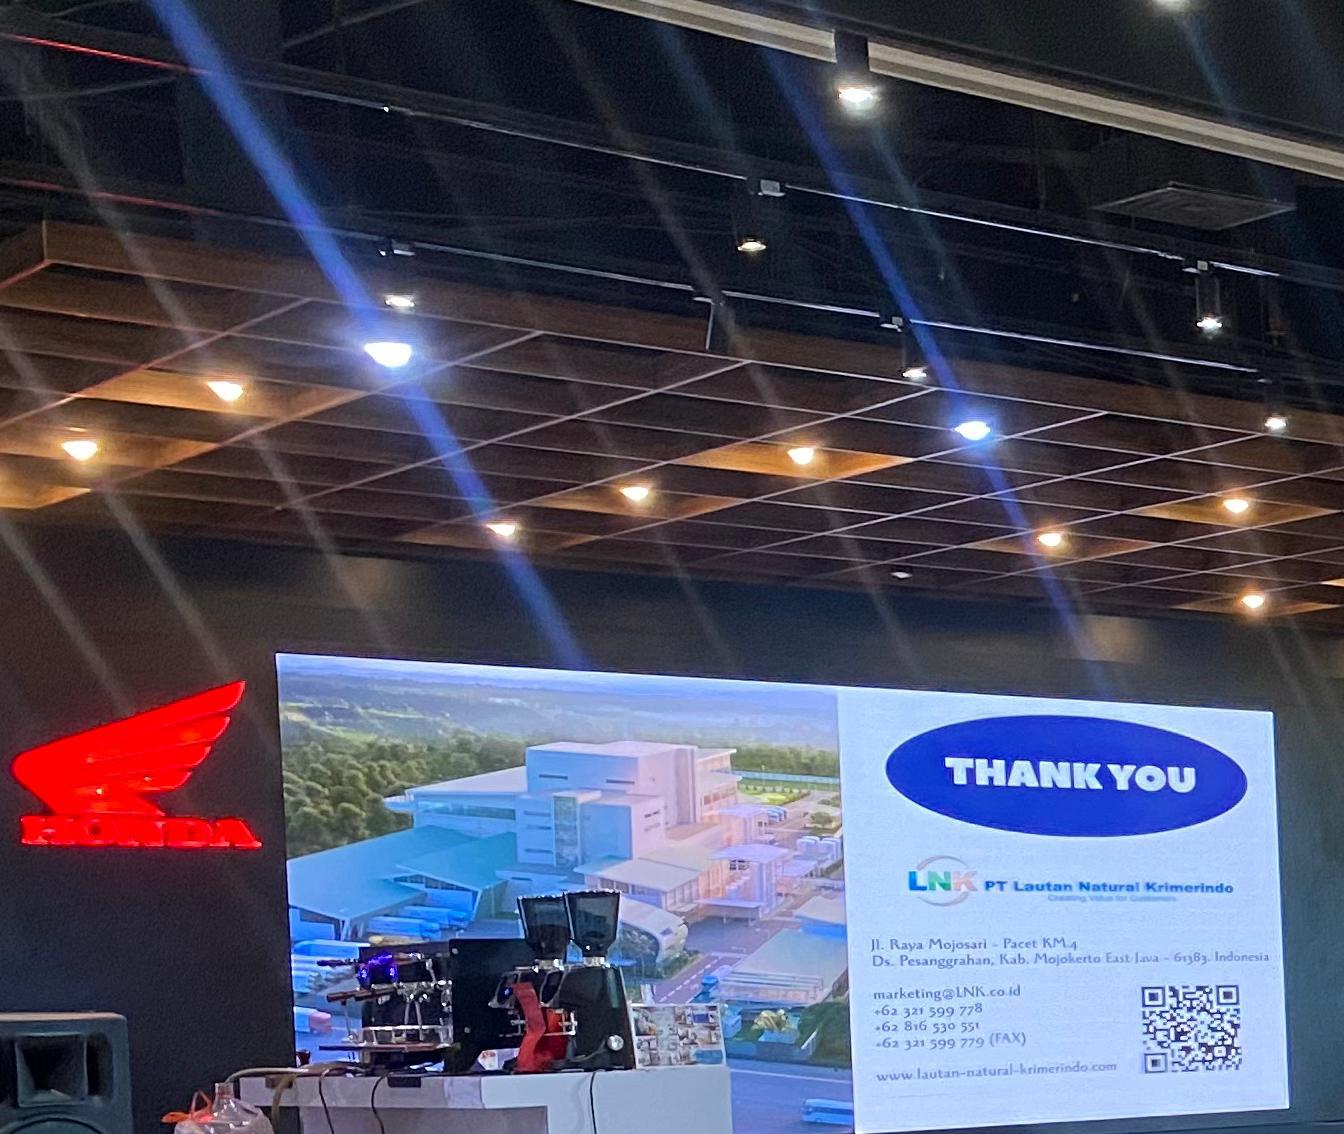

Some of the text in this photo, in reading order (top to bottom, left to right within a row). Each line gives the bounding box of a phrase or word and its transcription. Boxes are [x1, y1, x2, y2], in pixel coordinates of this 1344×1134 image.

[945, 757, 1196, 794] THANK YOU
[20, 814, 263, 847] HONDA
[908, 870, 978, 893] LNK
[984, 880, 1234, 895] PT Lautan Natural Krimerindo
[870, 938, 885, 952] Jl.
[890, 938, 924, 952] Raya
[928, 938, 987, 952] Mojosari
[1003, 937, 1038, 949] Pacet
[871, 954, 894, 967] Ds.
[899, 954, 995, 970] Pesanggrahan,
[999, 952, 1030, 966] Kab.
[1033, 952, 1101, 967] Mojokerto
[1105, 951, 1131, 964] East
[1135, 951, 1160, 964] Java
[1214, 950, 1270, 963] Indonesia
[873, 984, 1021, 1001] marketing@LNK.co.id
[874, 1002, 983, 1018] +62 321 599 778
[875, 1020, 980, 1034] +62 816 530 551
[875, 1031, 1027, 1051] +62 321 599 779 (FAX)
[876, 1061, 1118, 1082] www.lautan-natural-krimerindo.com
